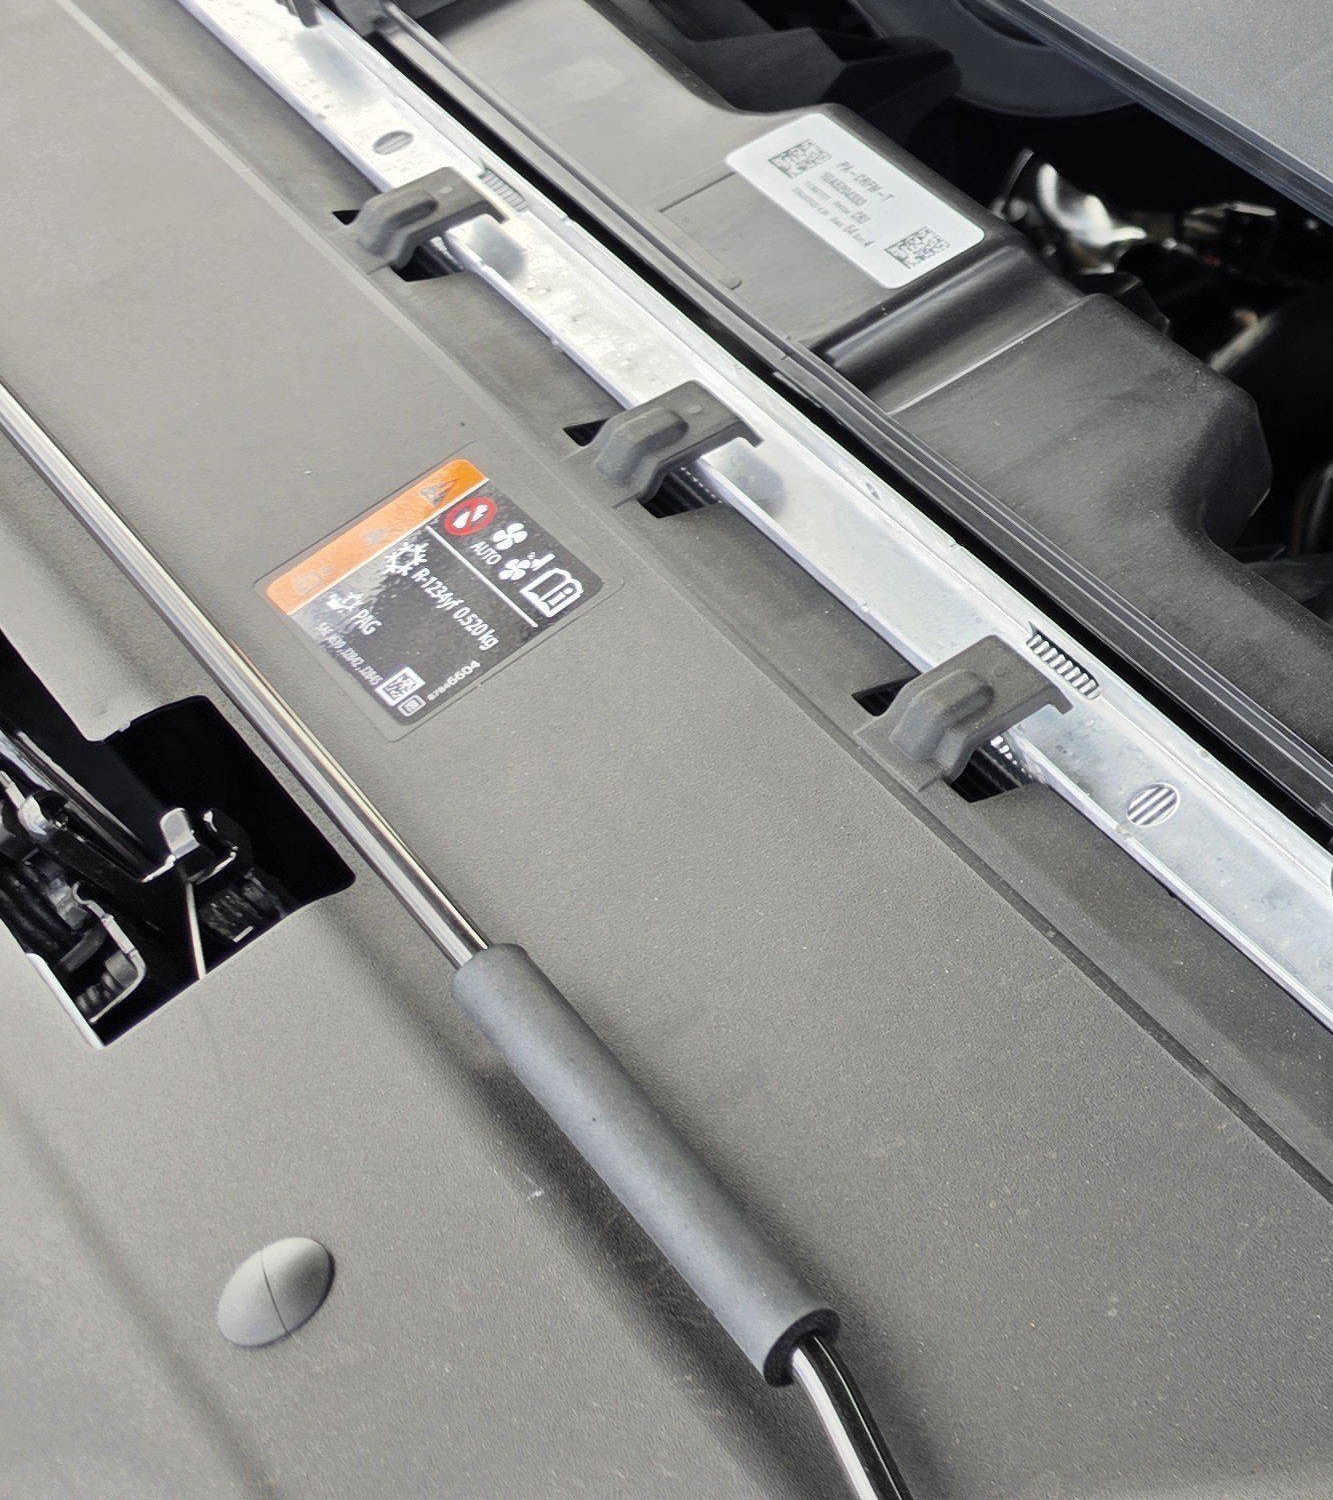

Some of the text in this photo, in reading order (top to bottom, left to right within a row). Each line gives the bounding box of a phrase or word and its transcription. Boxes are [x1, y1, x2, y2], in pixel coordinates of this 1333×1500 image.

[471, 542, 502, 564] AUTO
[351, 608, 382, 635] PAG
[411, 567, 464, 611] R-1234yf
[478, 628, 500, 651] kg
